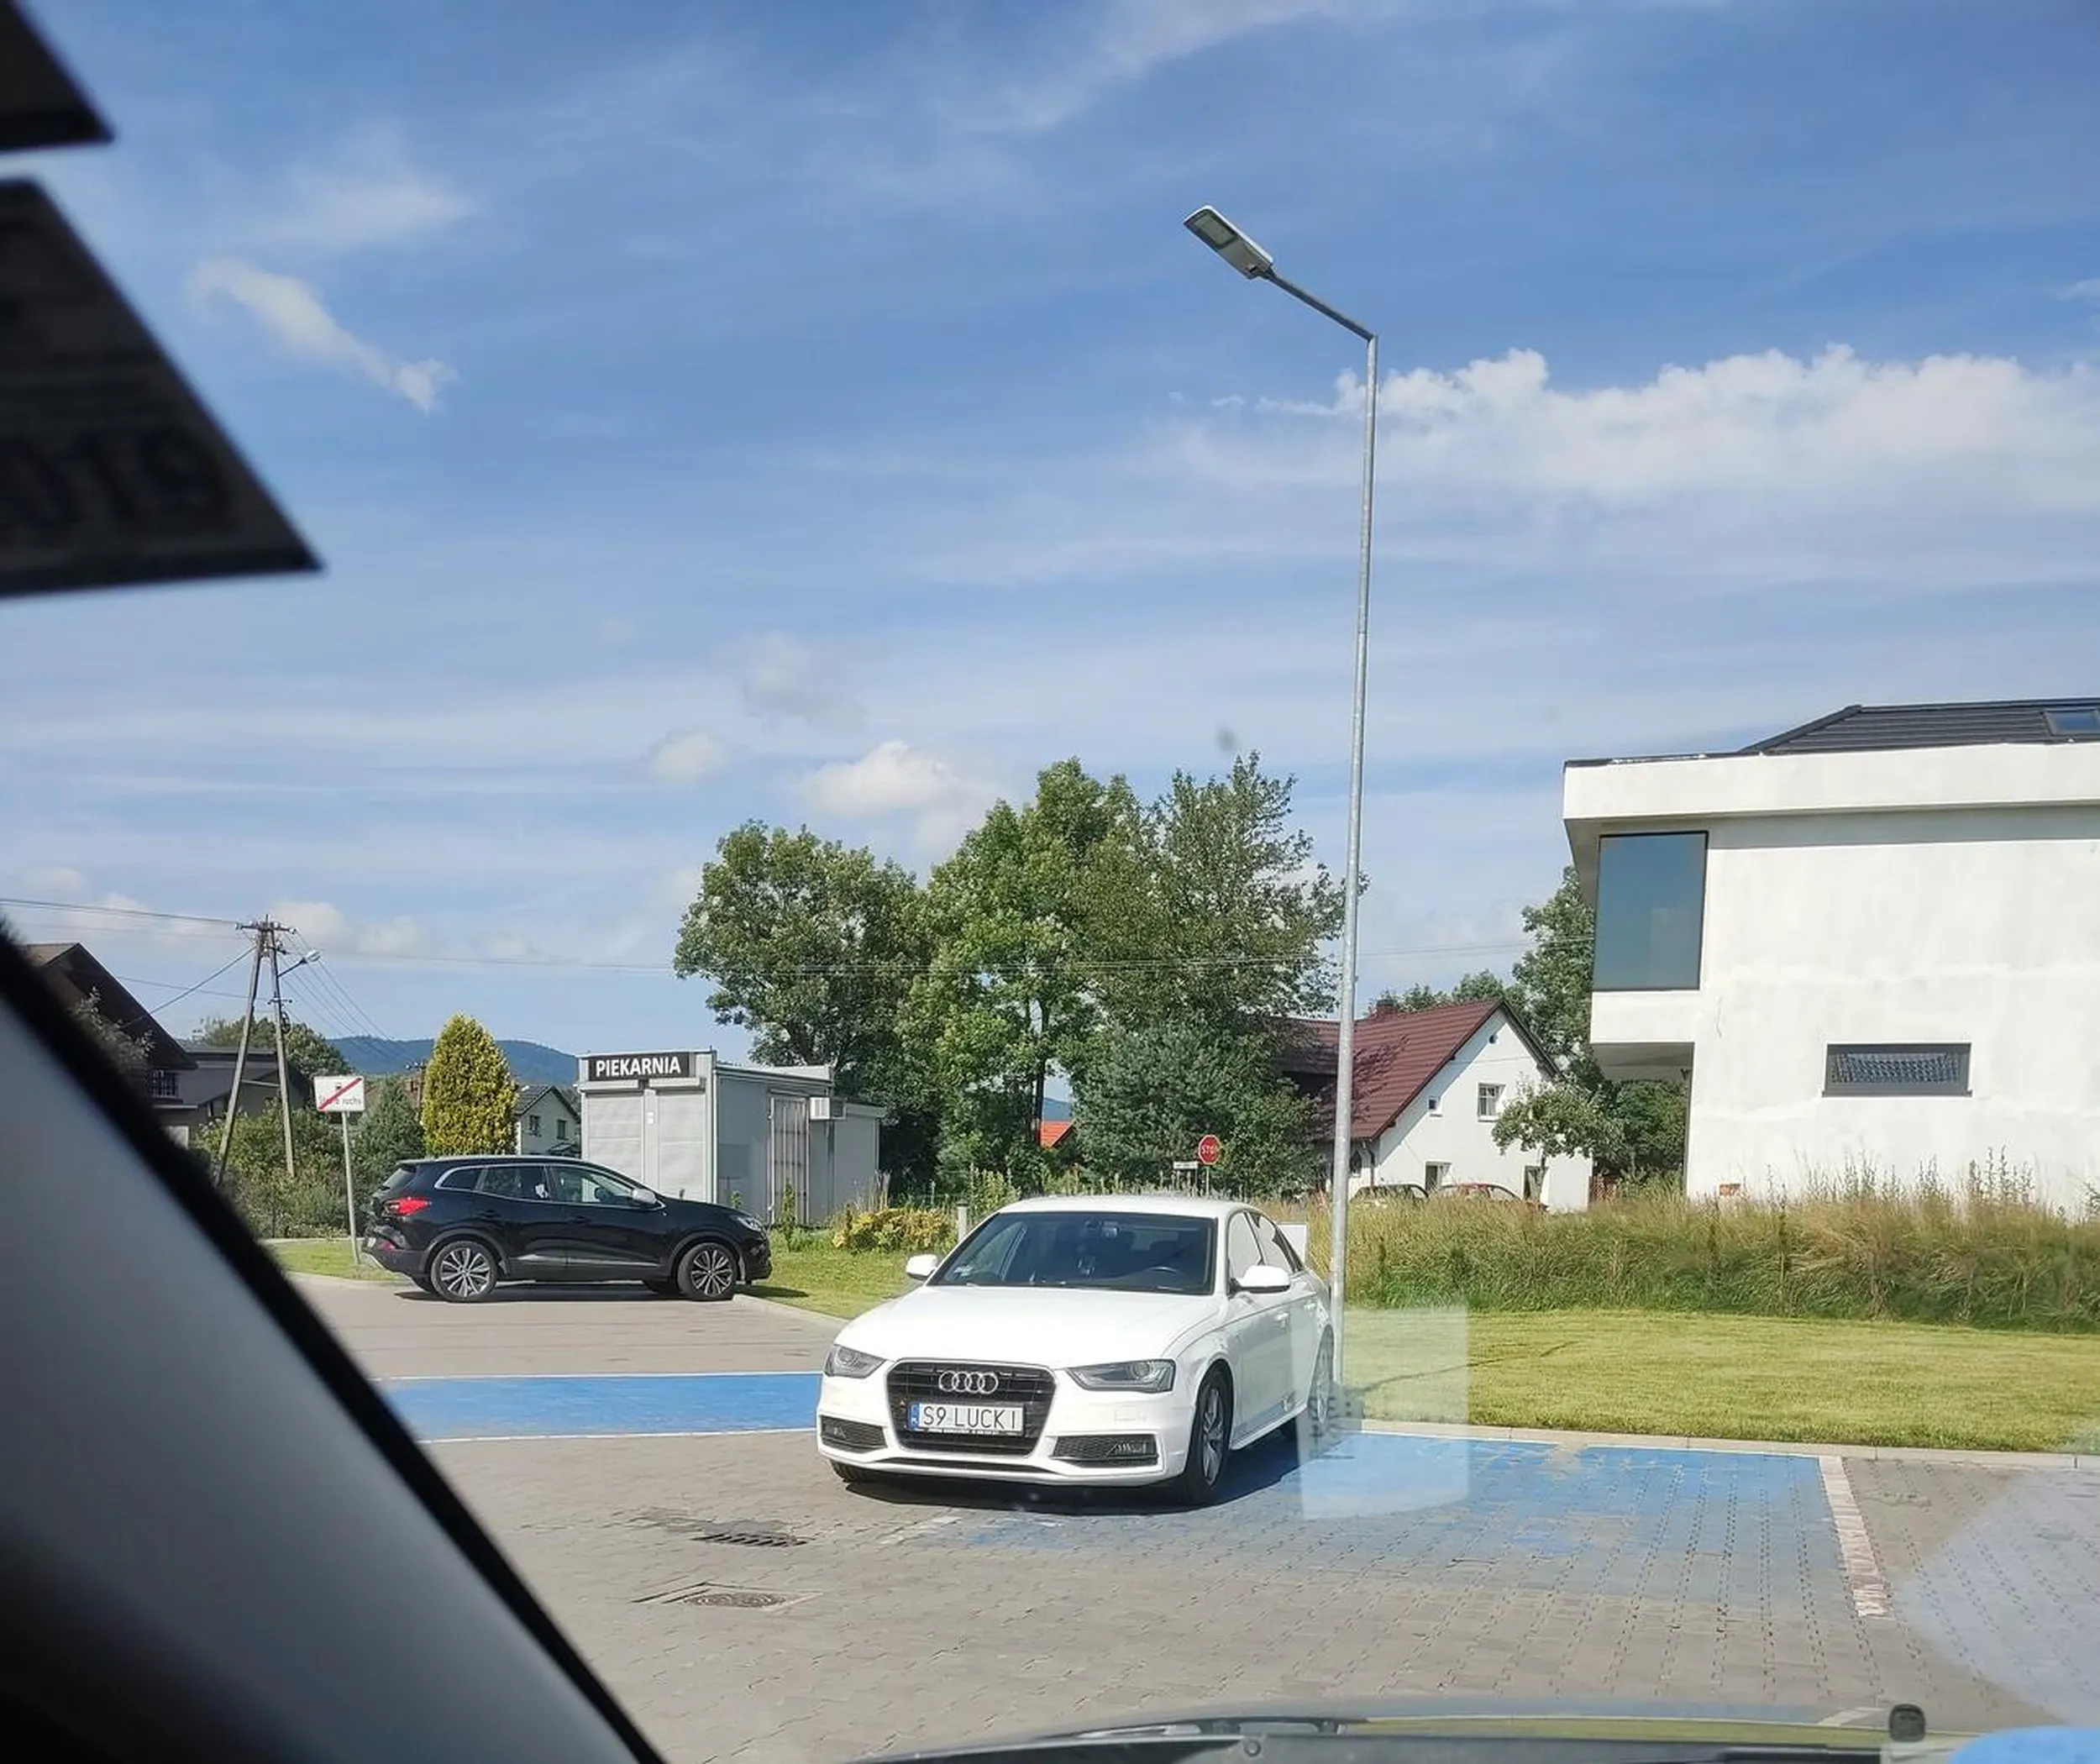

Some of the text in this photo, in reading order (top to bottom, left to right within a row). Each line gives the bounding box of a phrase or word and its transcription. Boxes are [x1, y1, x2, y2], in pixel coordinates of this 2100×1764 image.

[596, 1056, 681, 1077] PIEKARNIA
[924, 1406, 946, 1425] S9
[955, 1408, 1016, 1430] LUCKI
